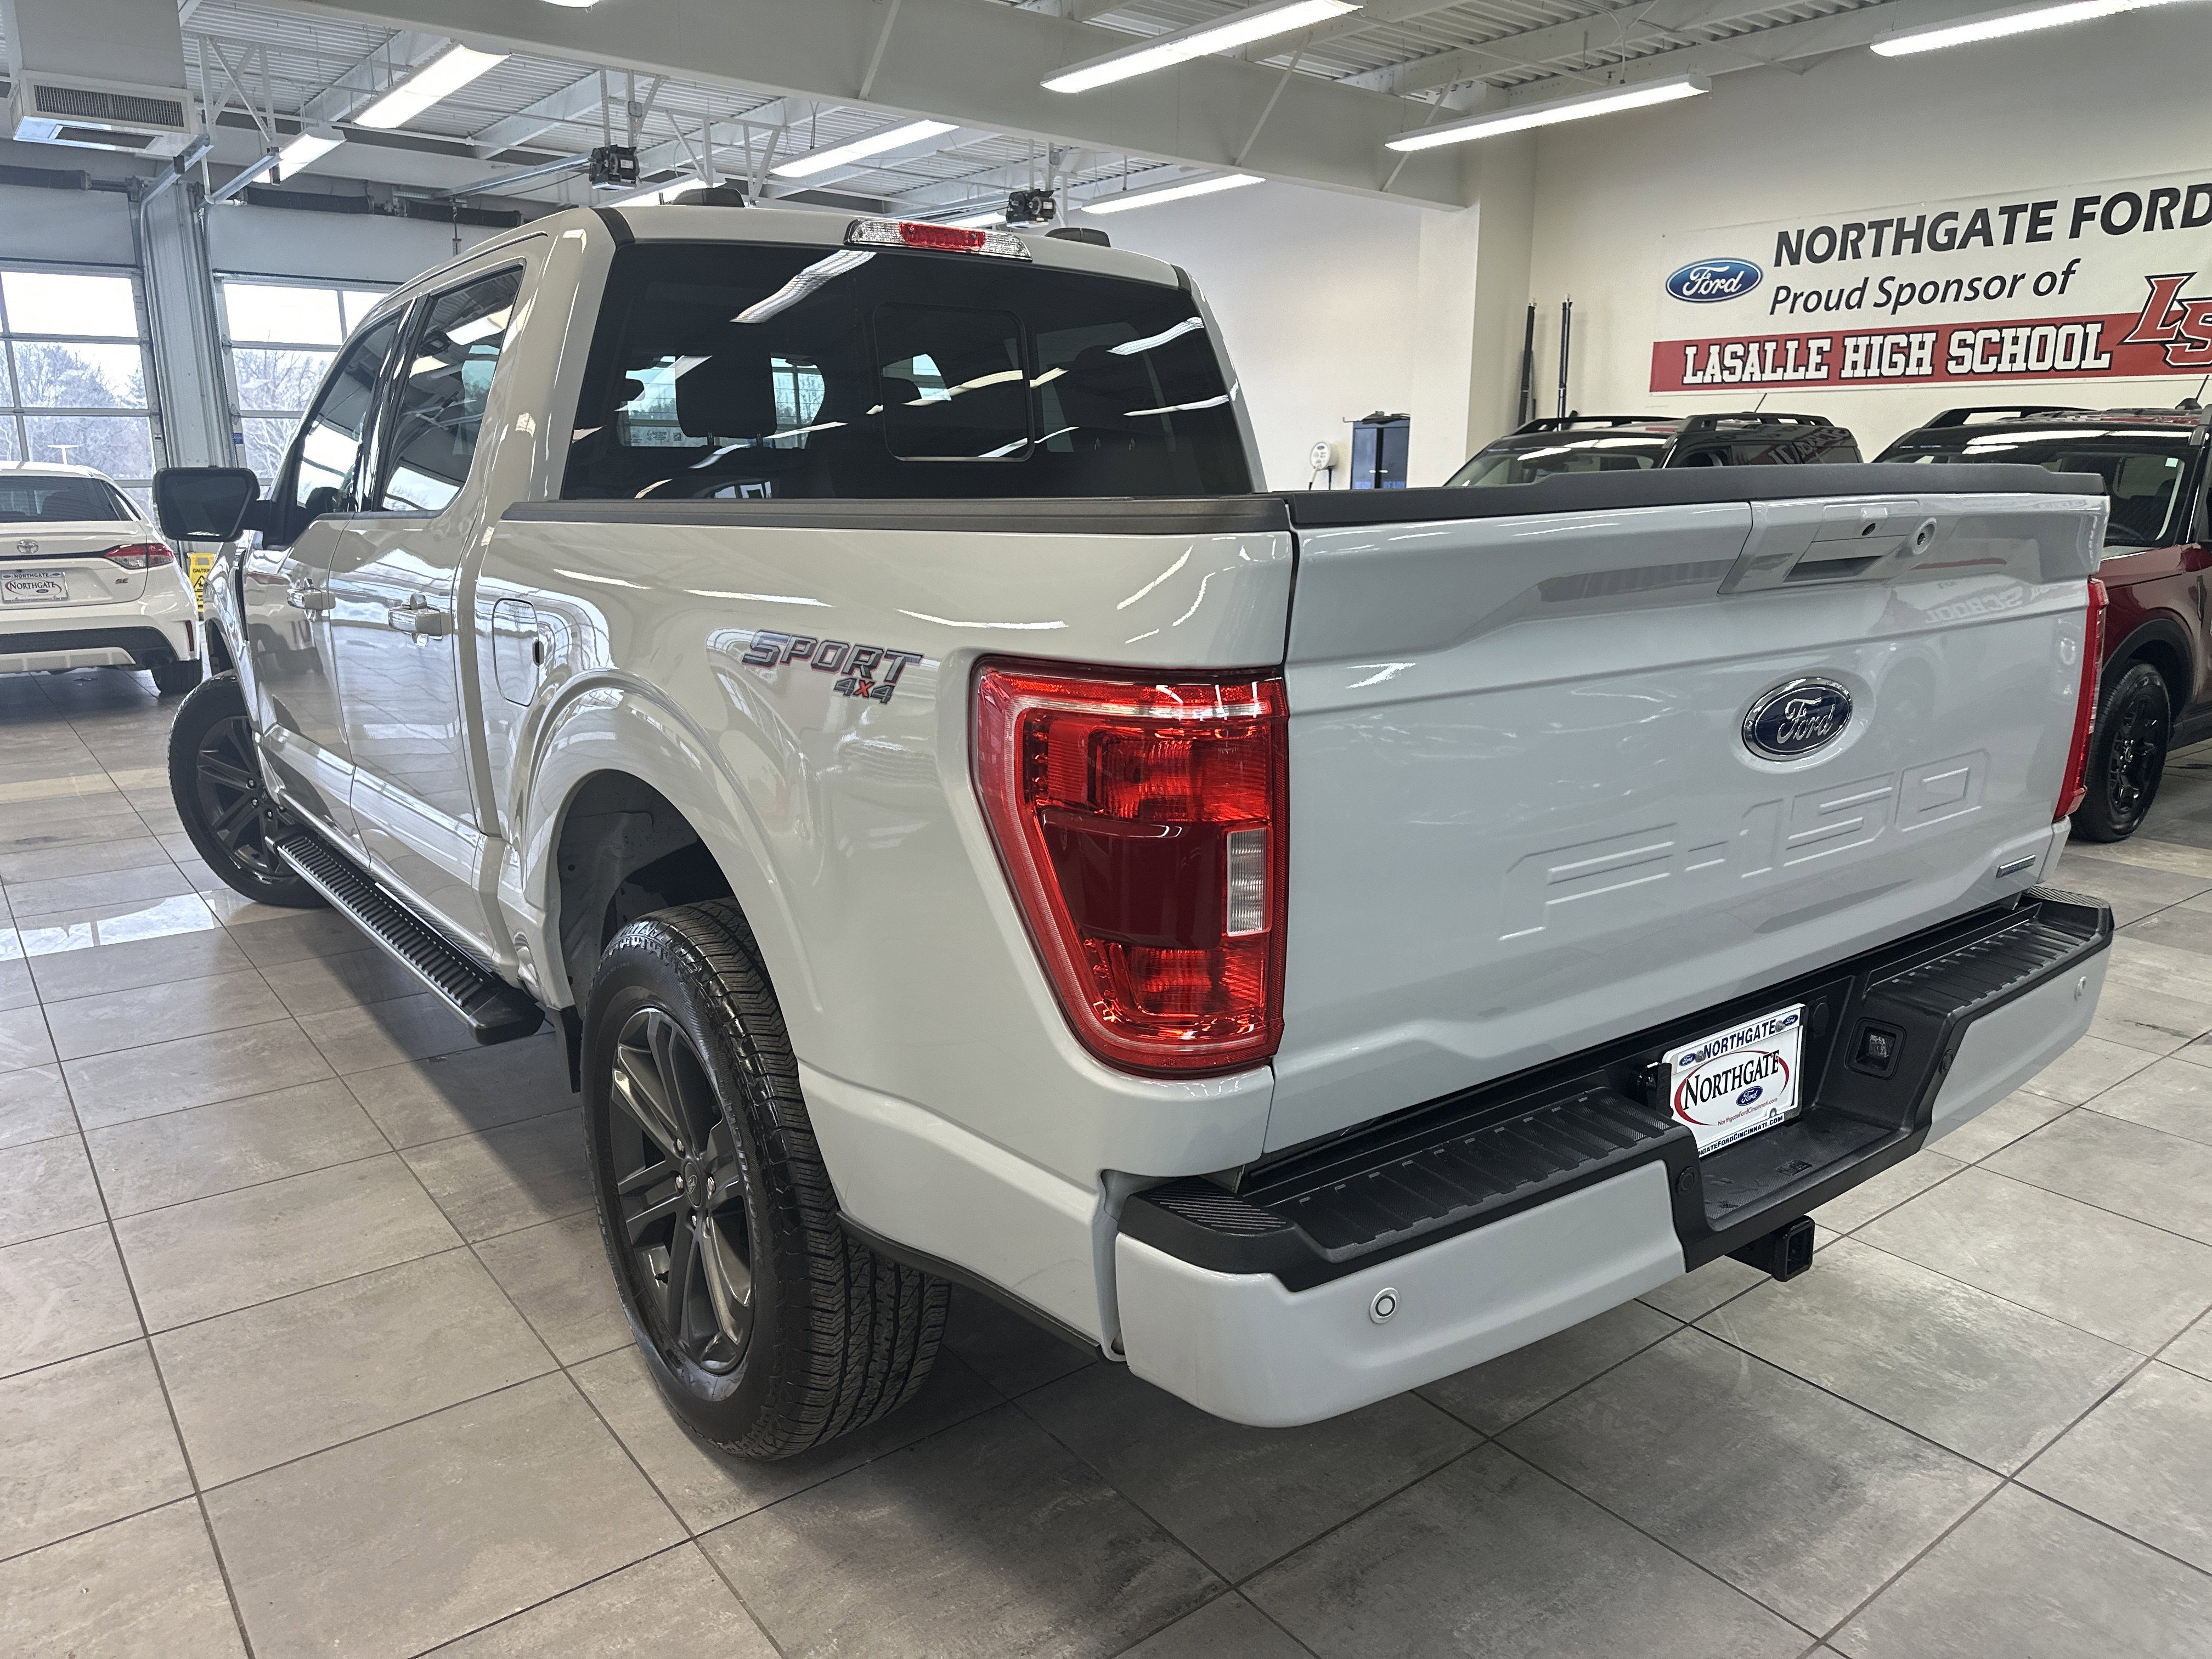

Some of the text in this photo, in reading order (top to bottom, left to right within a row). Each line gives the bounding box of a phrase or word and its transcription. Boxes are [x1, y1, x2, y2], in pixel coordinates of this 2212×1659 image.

[1774, 183, 2212, 267] NORTHGATE FORD
[1681, 264, 1746, 297] Ford
[1770, 258, 2081, 315] Proud Sponsor of
[1682, 321, 2113, 385] LASALLE HIGH SCHOOL
[9, 581, 55, 590] NORTHGATE
[741, 628, 926, 685] SPORT
[1776, 696, 1836, 744] Ford
[1703, 1019, 1776, 1059] NORTHGATE
